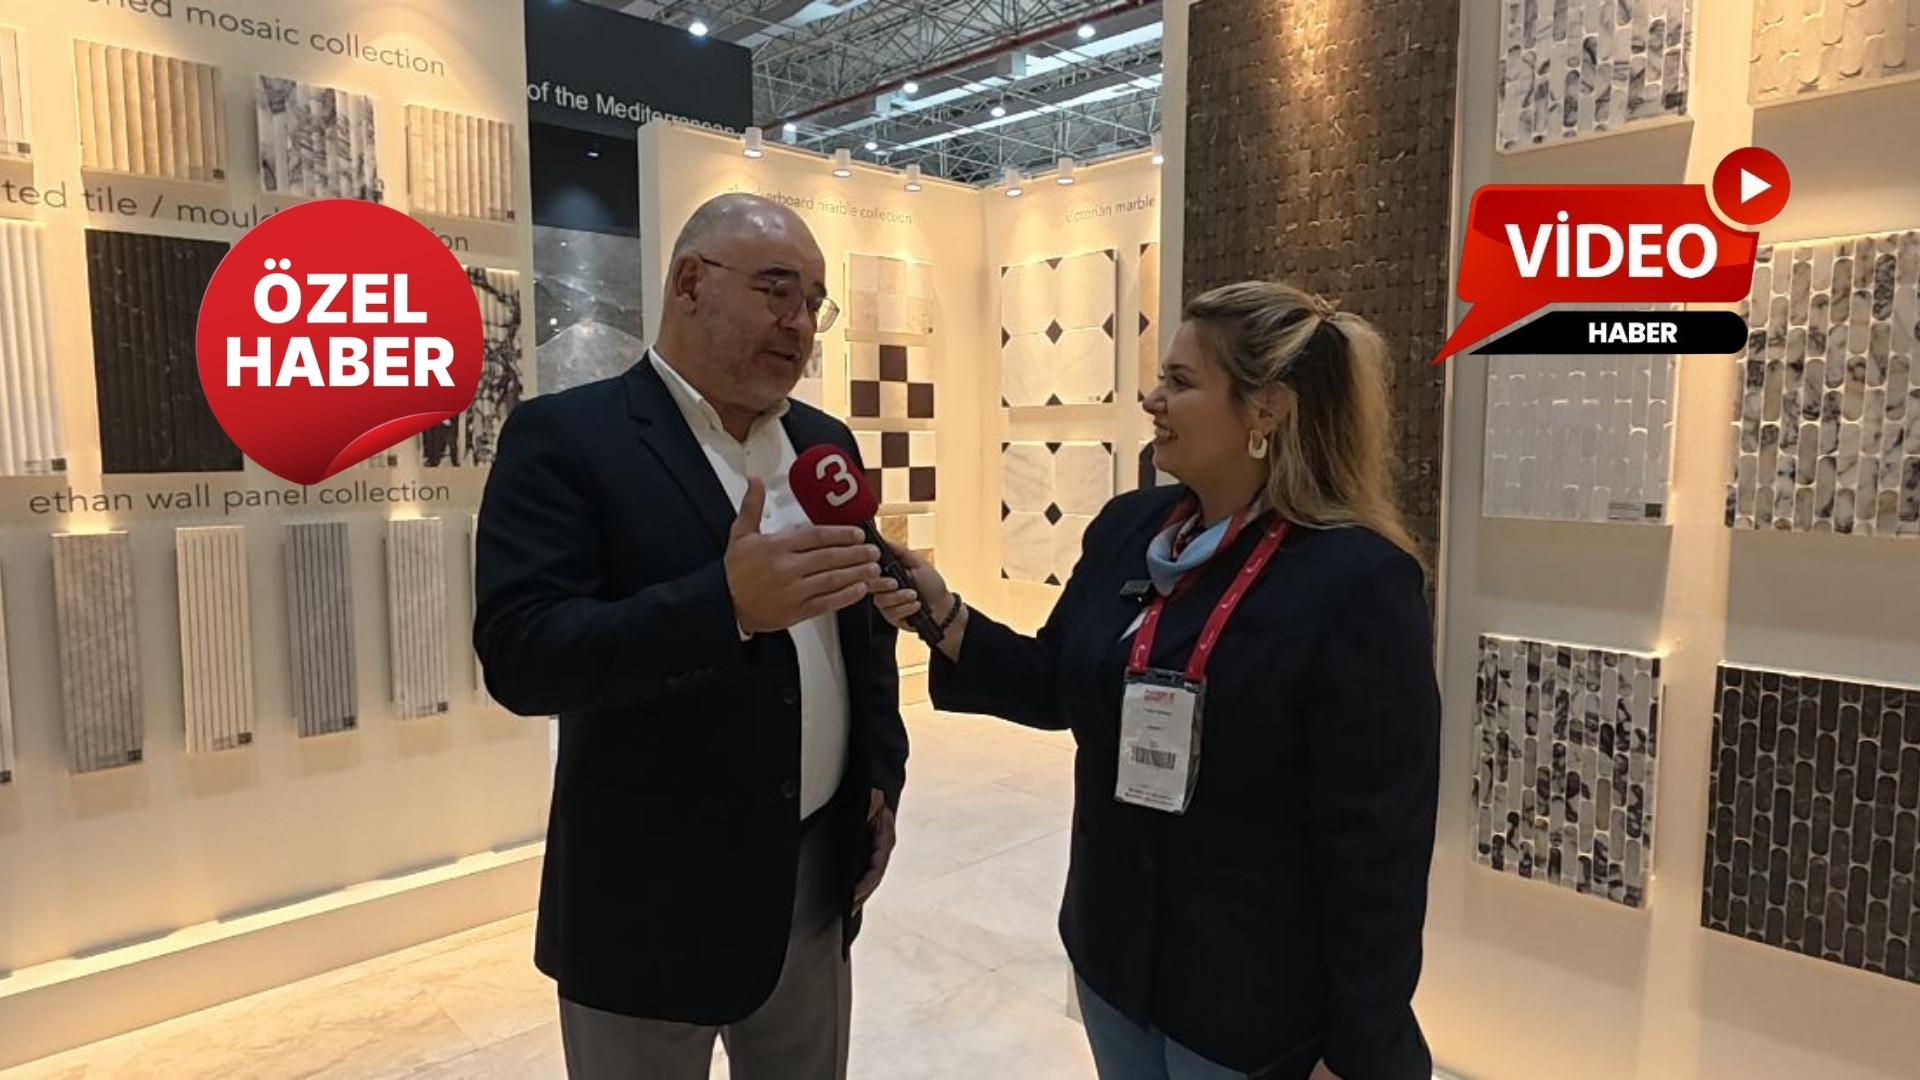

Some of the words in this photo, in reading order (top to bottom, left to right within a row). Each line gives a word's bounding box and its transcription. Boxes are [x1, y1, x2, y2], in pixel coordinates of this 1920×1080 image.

[187, 6, 299, 46] mosaic
[309, 32, 445, 77] collection
[527, 82, 550, 102] of
[555, 86, 589, 111] the
[2, 180, 68, 208] ted
[81, 185, 138, 216] tile
[1115, 194, 1157, 213] marble
[29, 486, 133, 514] ethan
[146, 482, 211, 510] wall
[223, 485, 309, 516] panel
[318, 479, 450, 505] collection
[815, 453, 859, 507] 3
